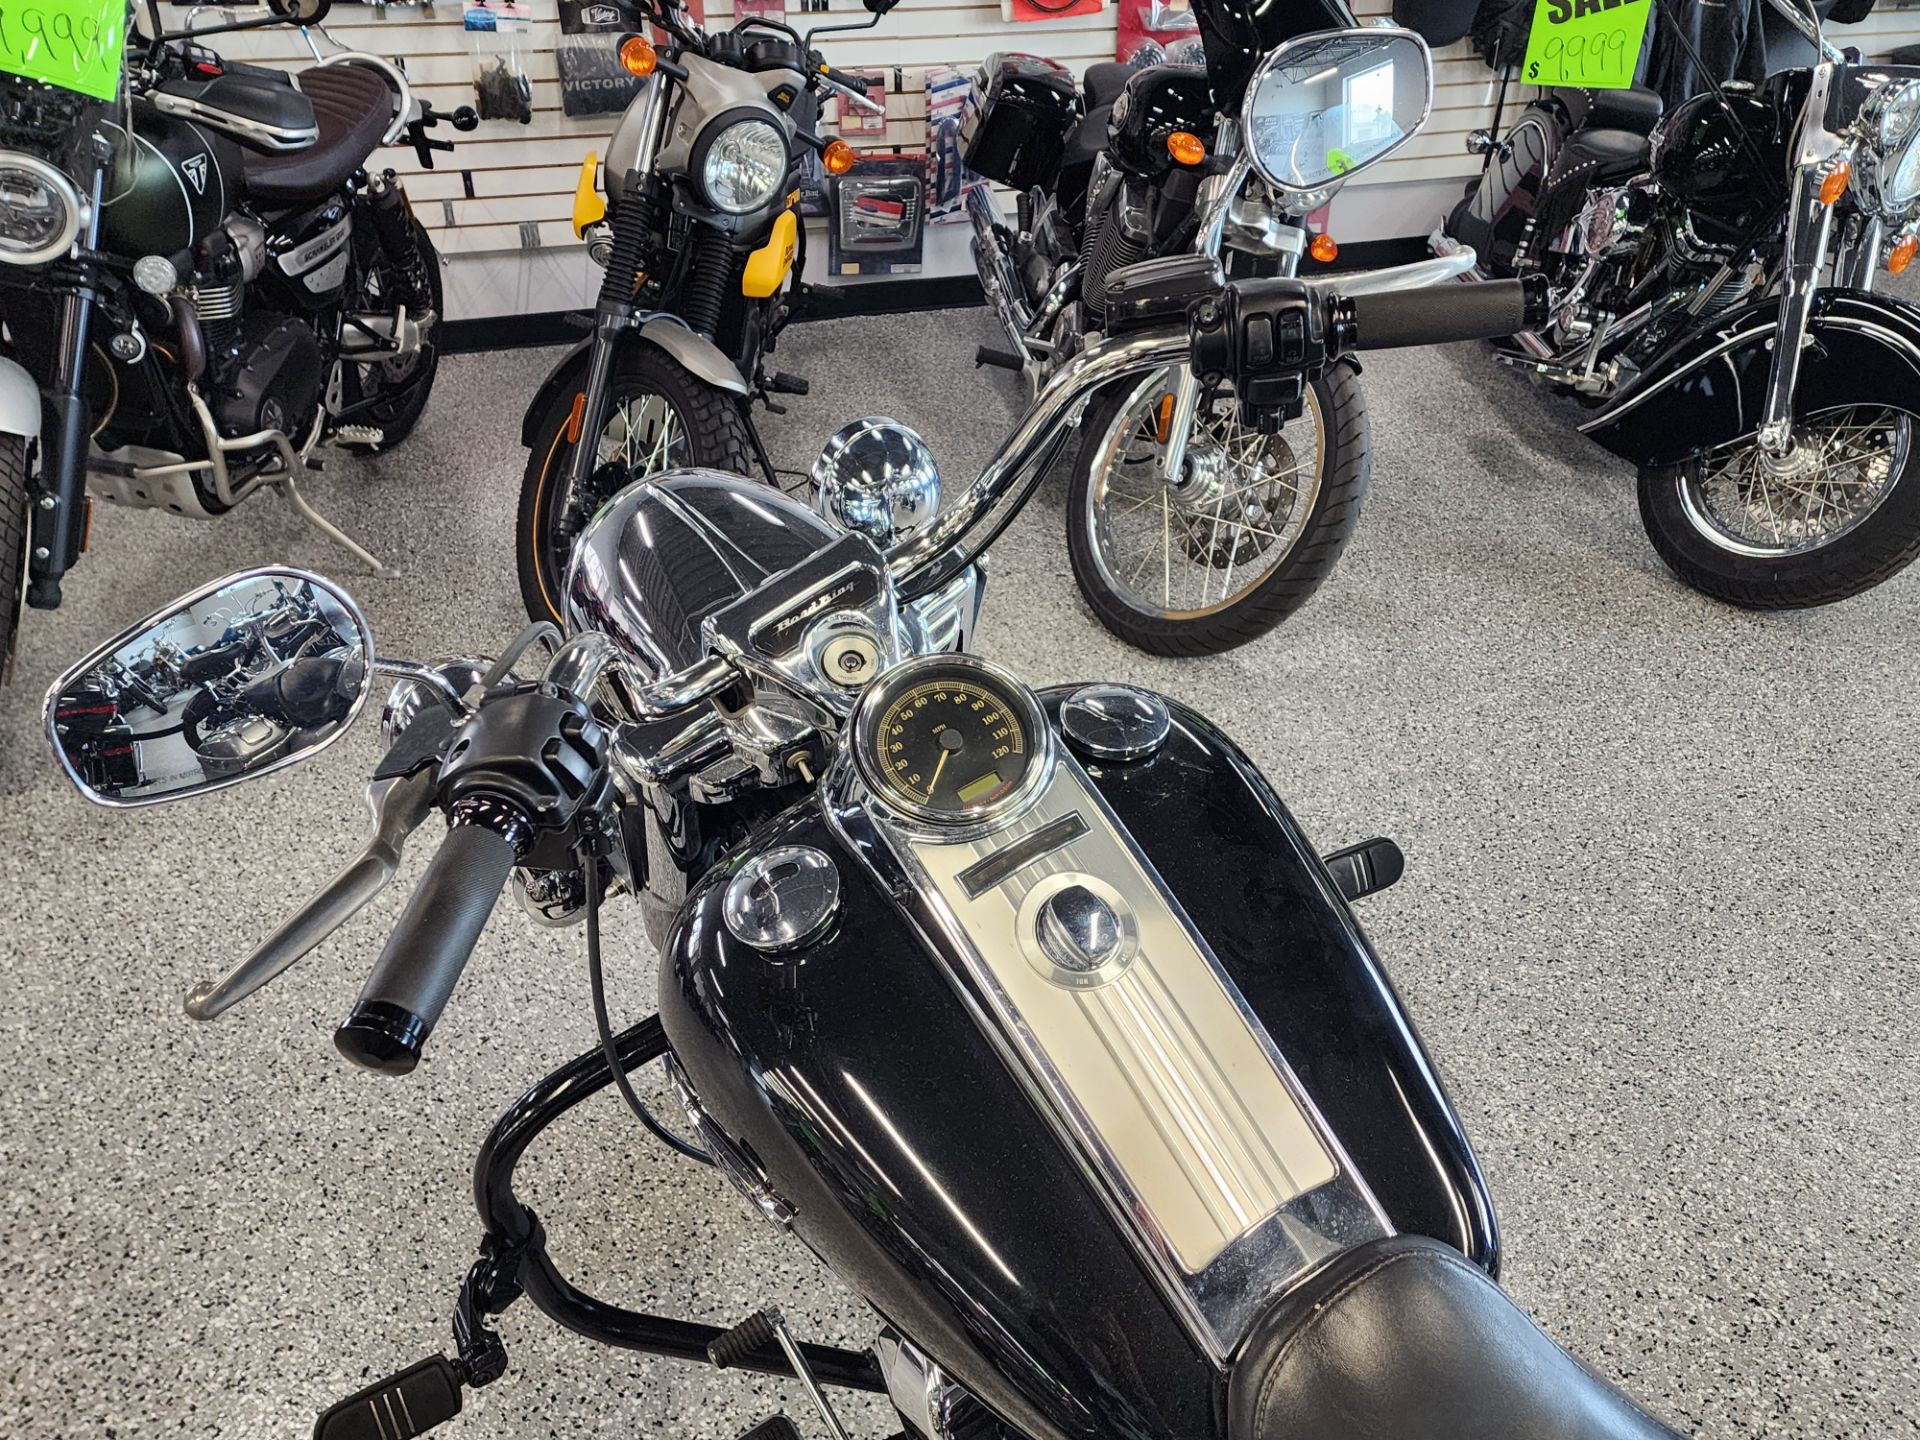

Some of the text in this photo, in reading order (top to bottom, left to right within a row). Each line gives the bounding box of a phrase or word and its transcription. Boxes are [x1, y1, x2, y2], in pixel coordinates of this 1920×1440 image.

[564, 78, 636, 92] VICTORY
[914, 697, 928, 708] 60
[934, 692, 947, 703] 70
[954, 693, 967, 704] 80
[971, 700, 985, 711] 90
[900, 709, 914, 720] 50
[982, 711, 1000, 726] 100
[891, 724, 904, 736] 40
[932, 723, 947, 735] MPH
[992, 727, 1009, 740] 110
[890, 741, 903, 753] 30
[991, 745, 1010, 759] 120
[895, 759, 908, 770] 20
[908, 773, 921, 785] 10
